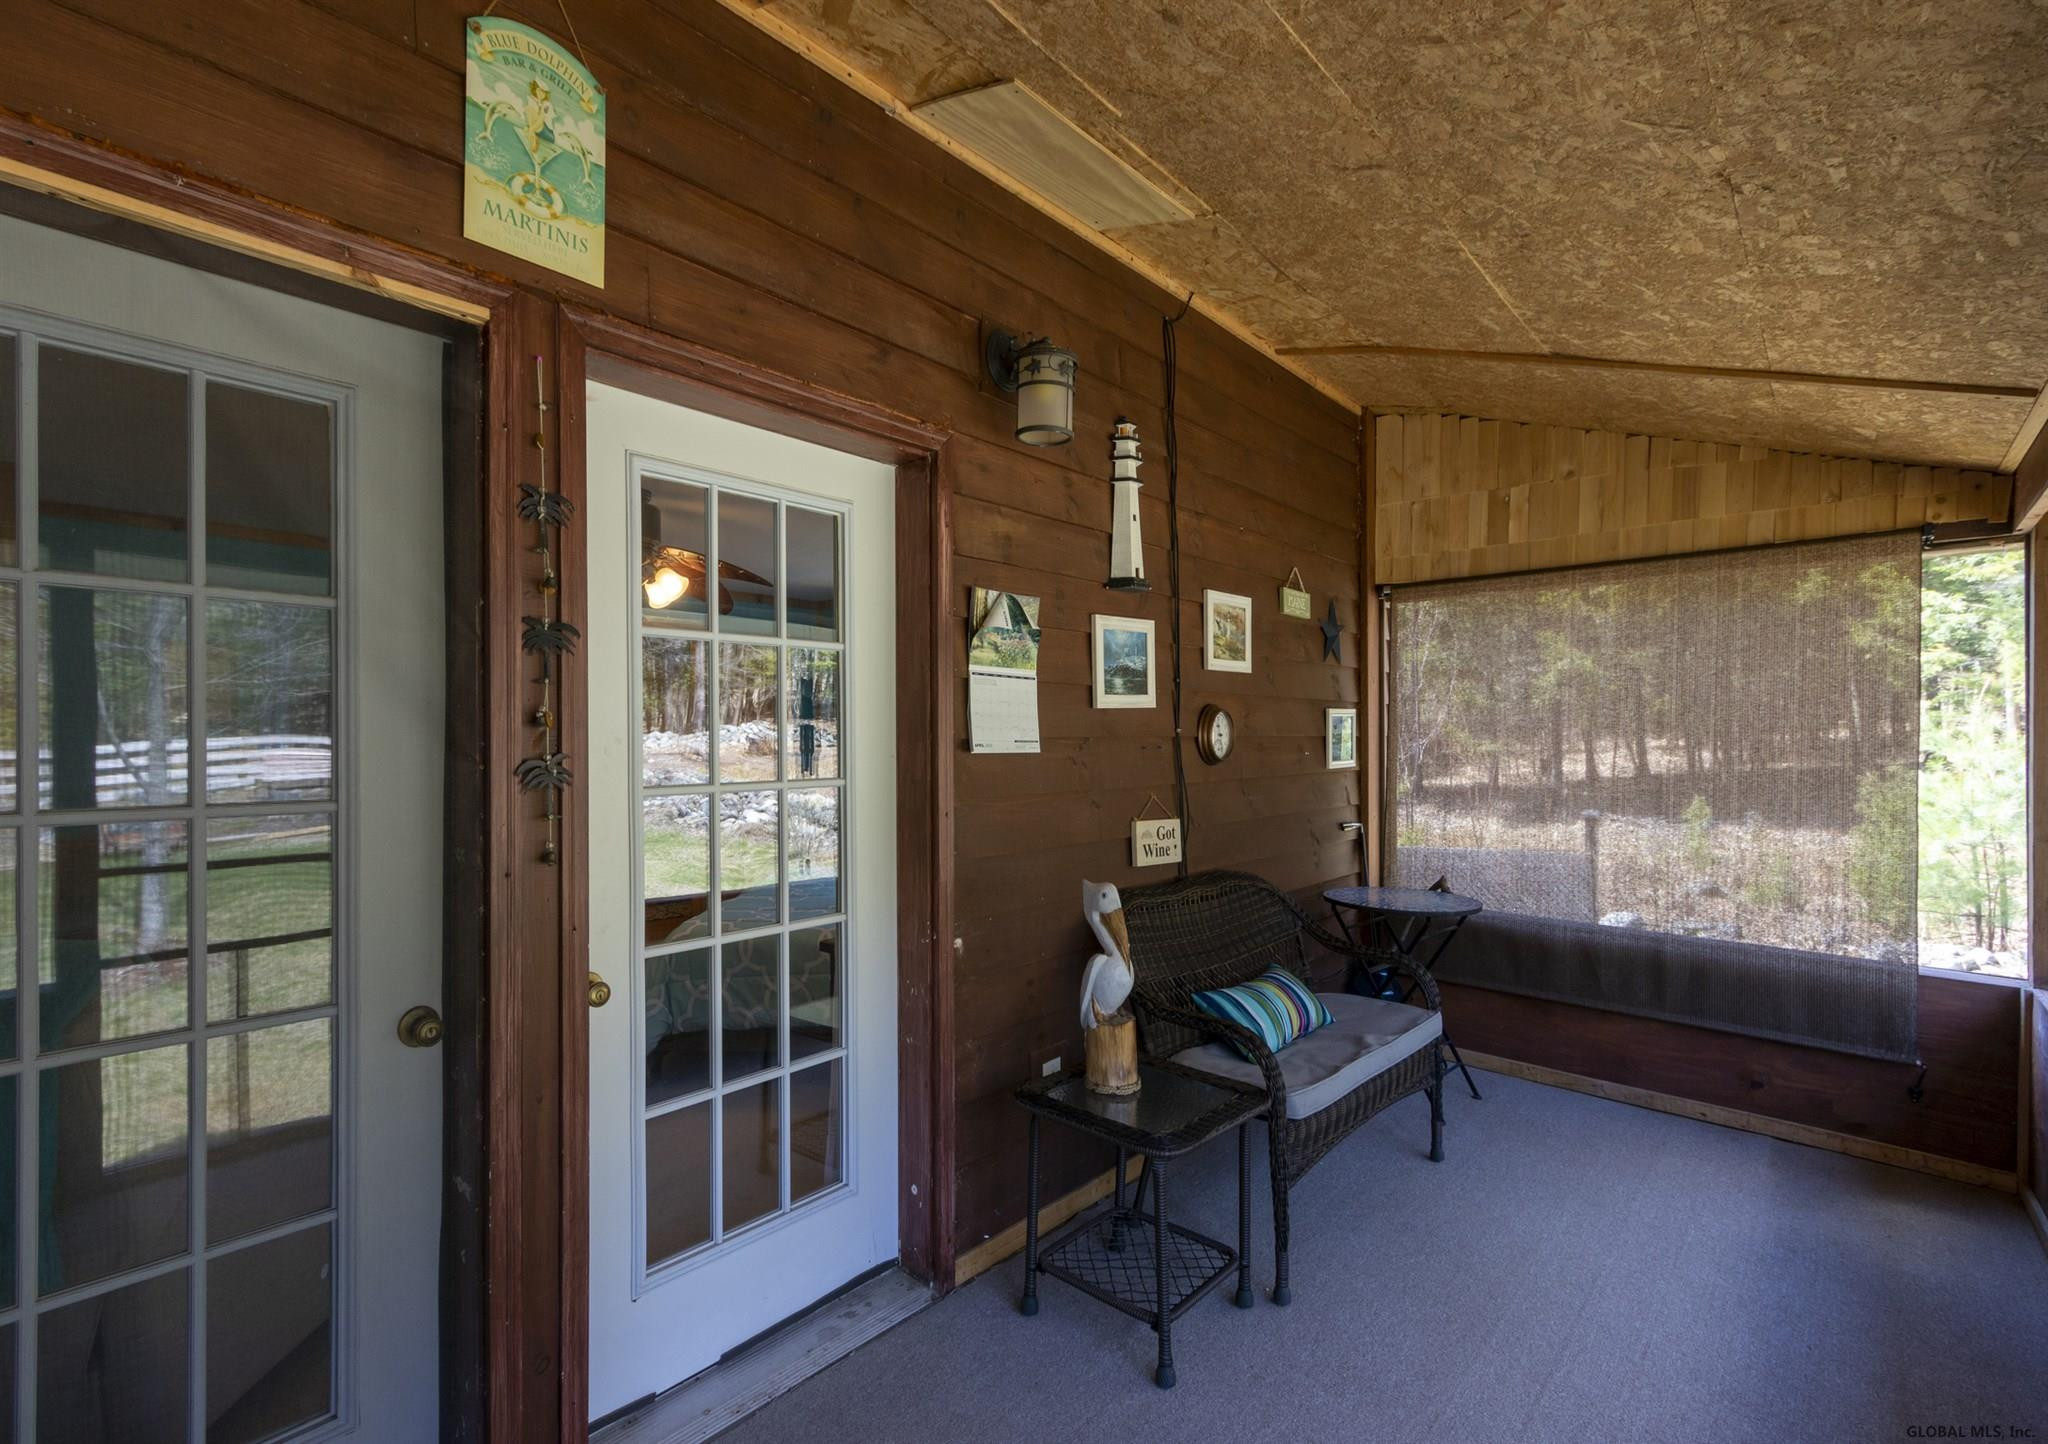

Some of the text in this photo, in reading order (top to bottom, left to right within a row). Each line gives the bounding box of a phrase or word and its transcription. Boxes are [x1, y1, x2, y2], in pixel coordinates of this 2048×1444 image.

[486, 32, 590, 95] BLUE DOLPHIN
[501, 55, 574, 97] BAR & GRILL
[482, 198, 589, 254] MARTINIS
[1156, 825, 1176, 841] Got
